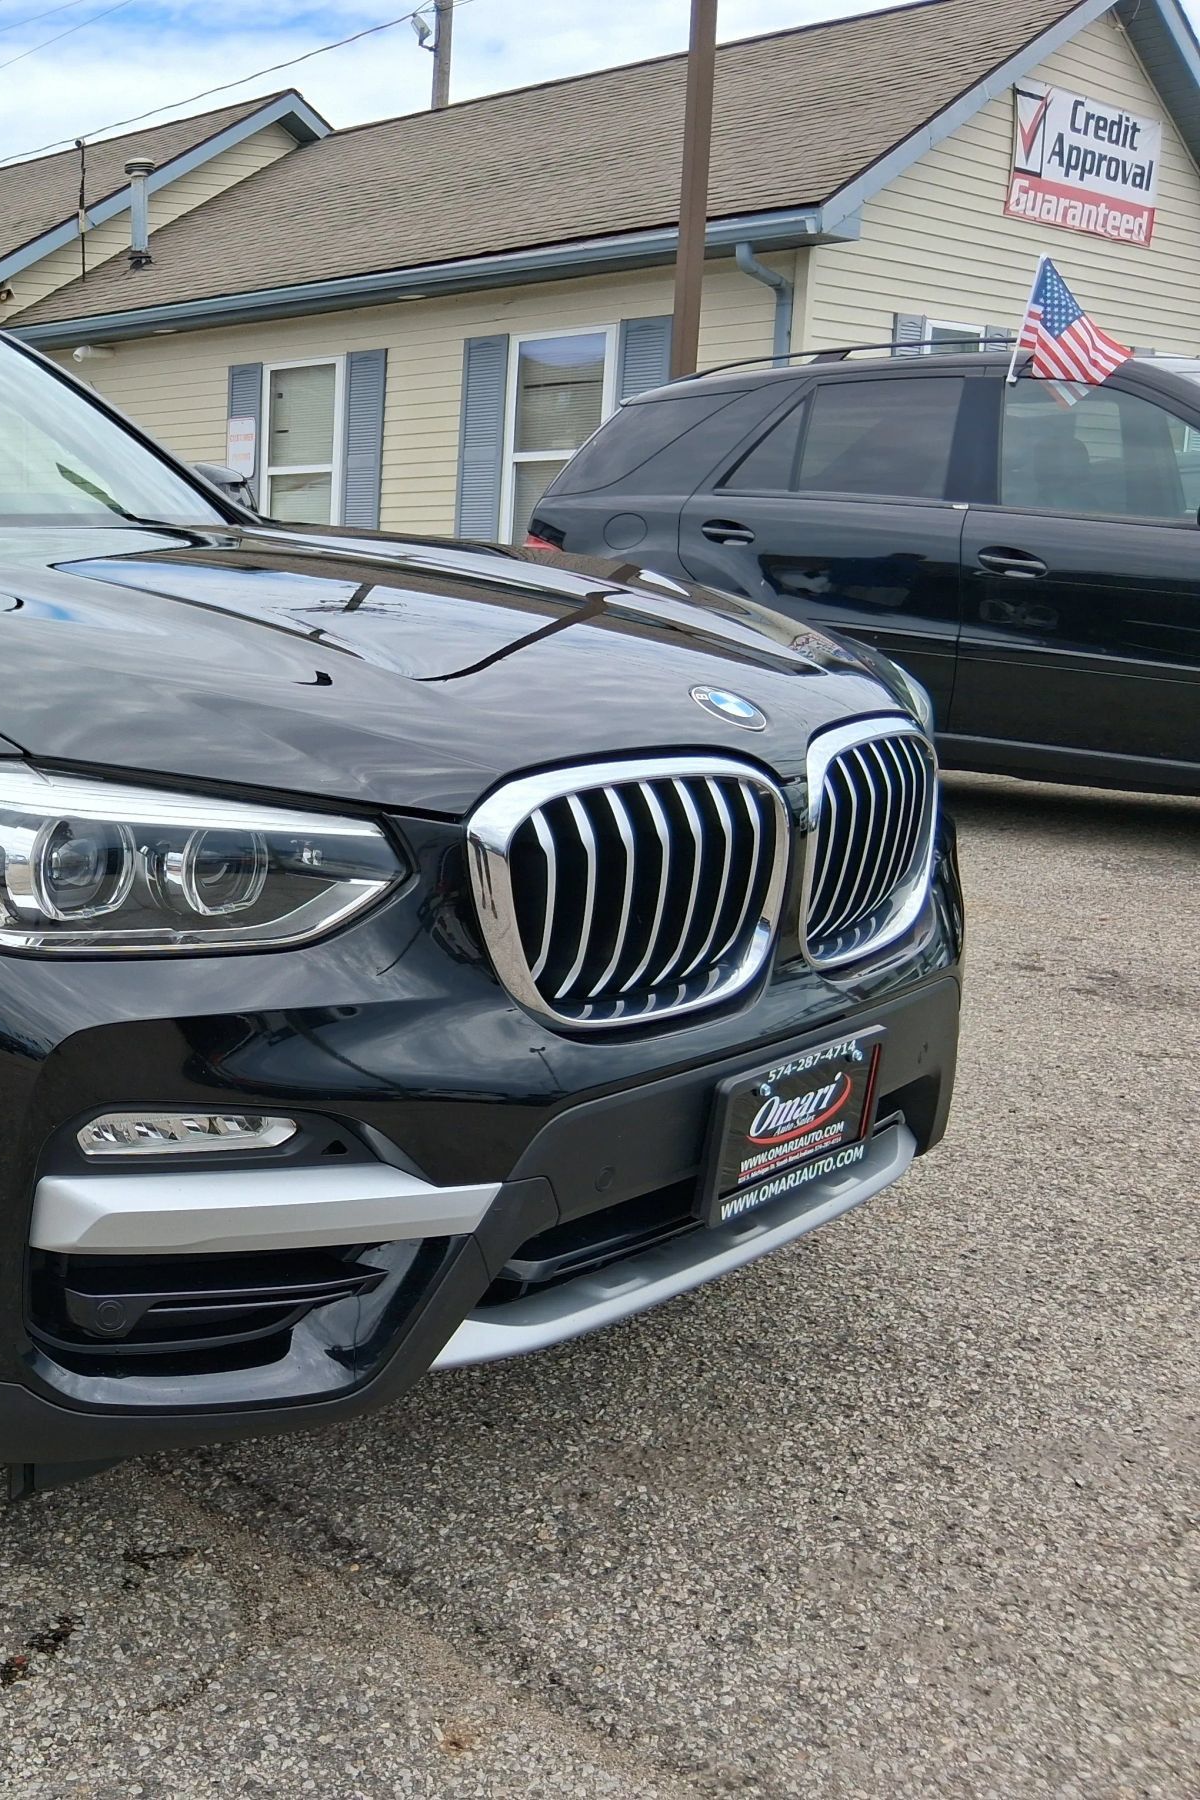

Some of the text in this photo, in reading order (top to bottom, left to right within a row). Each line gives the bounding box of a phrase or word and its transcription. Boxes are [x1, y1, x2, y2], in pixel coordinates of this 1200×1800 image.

[1069, 99, 1141, 151] Credit
[1047, 132, 1154, 192] Approval
[1009, 178, 1149, 242] Guaranteed
[767, 1039, 857, 1083] 574-287-4714
[749, 1071, 842, 1137] Omari
[740, 1120, 844, 1173] WWW.OMARIAUTO.COM
[720, 1144, 865, 1221] WWW.OMARIAUTO.COM
